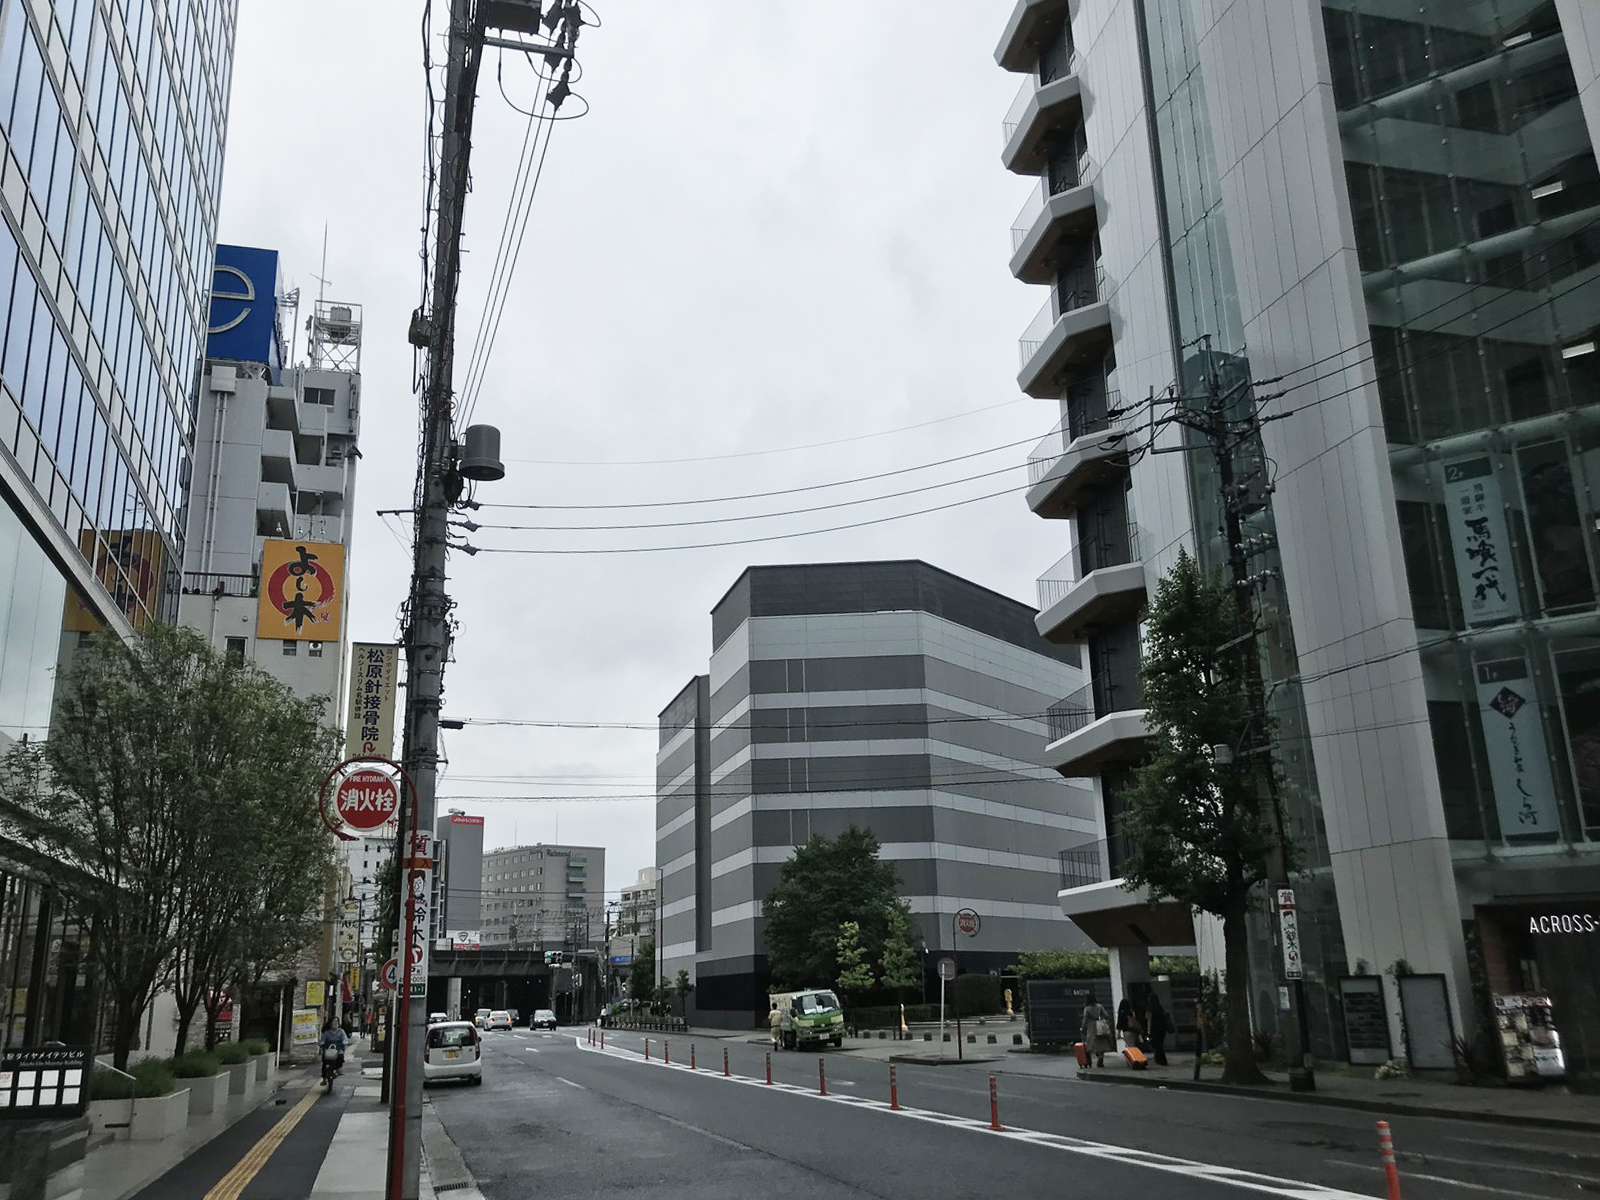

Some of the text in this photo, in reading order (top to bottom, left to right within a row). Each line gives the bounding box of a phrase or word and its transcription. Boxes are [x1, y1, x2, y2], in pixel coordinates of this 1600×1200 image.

[1464, 516, 1508, 602] 馬喰一代
[361, 648, 385, 742] 松原針接骨院
[340, 788, 394, 812] 消火栓
[349, 775, 388, 783] FIRE HYDRANT
